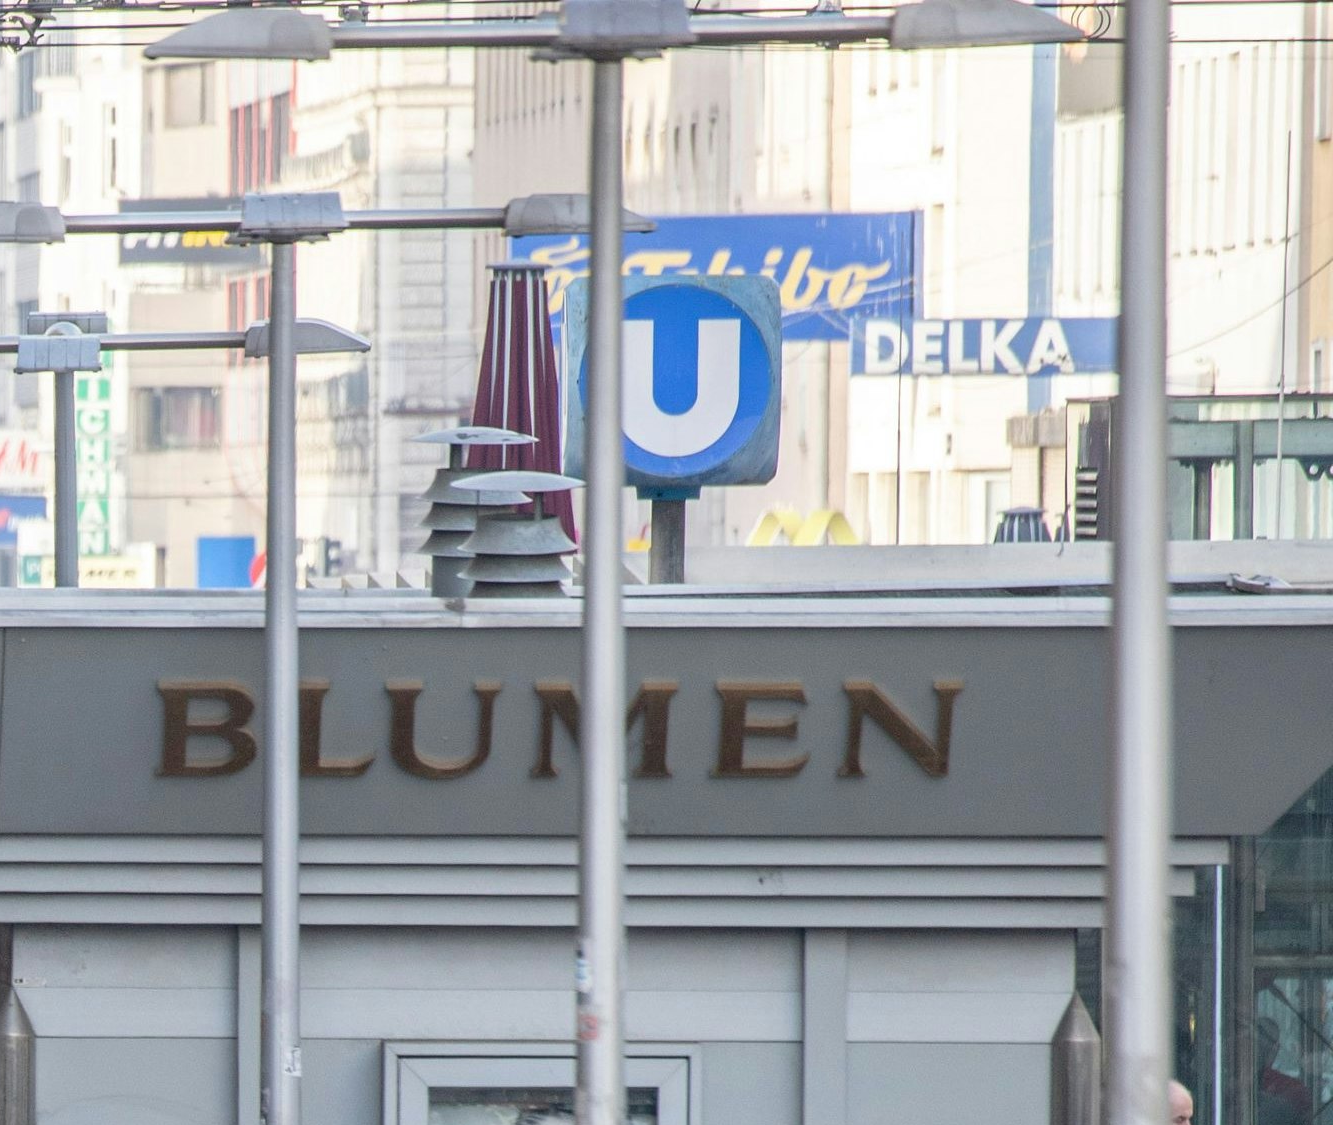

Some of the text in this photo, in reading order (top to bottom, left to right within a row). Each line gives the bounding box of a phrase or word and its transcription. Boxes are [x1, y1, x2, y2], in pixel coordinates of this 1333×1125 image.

[621, 319, 741, 458] U
[864, 319, 1076, 376] DELKA
[155, 678, 964, 780] BLUMEN
